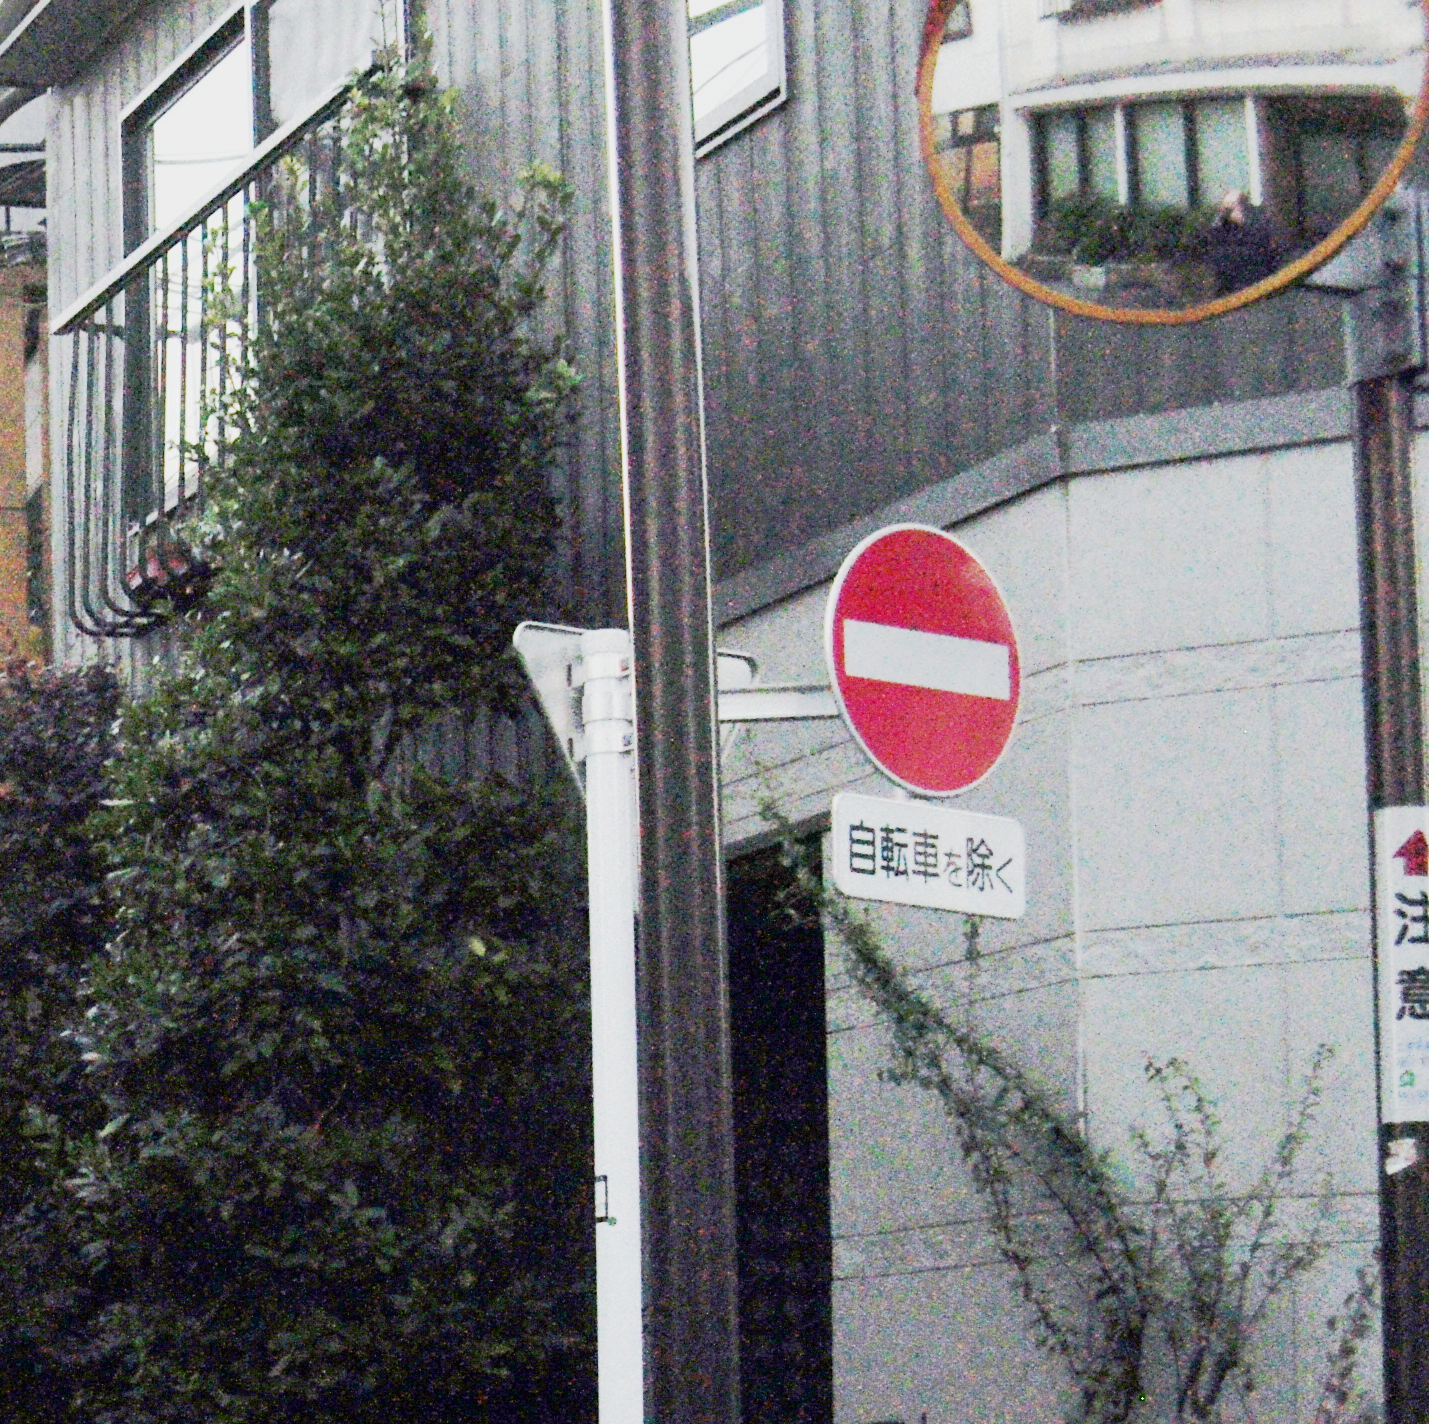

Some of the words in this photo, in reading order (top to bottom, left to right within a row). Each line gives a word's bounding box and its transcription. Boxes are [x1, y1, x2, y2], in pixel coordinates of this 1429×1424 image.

[848, 819, 1014, 895] 自転車を除く
